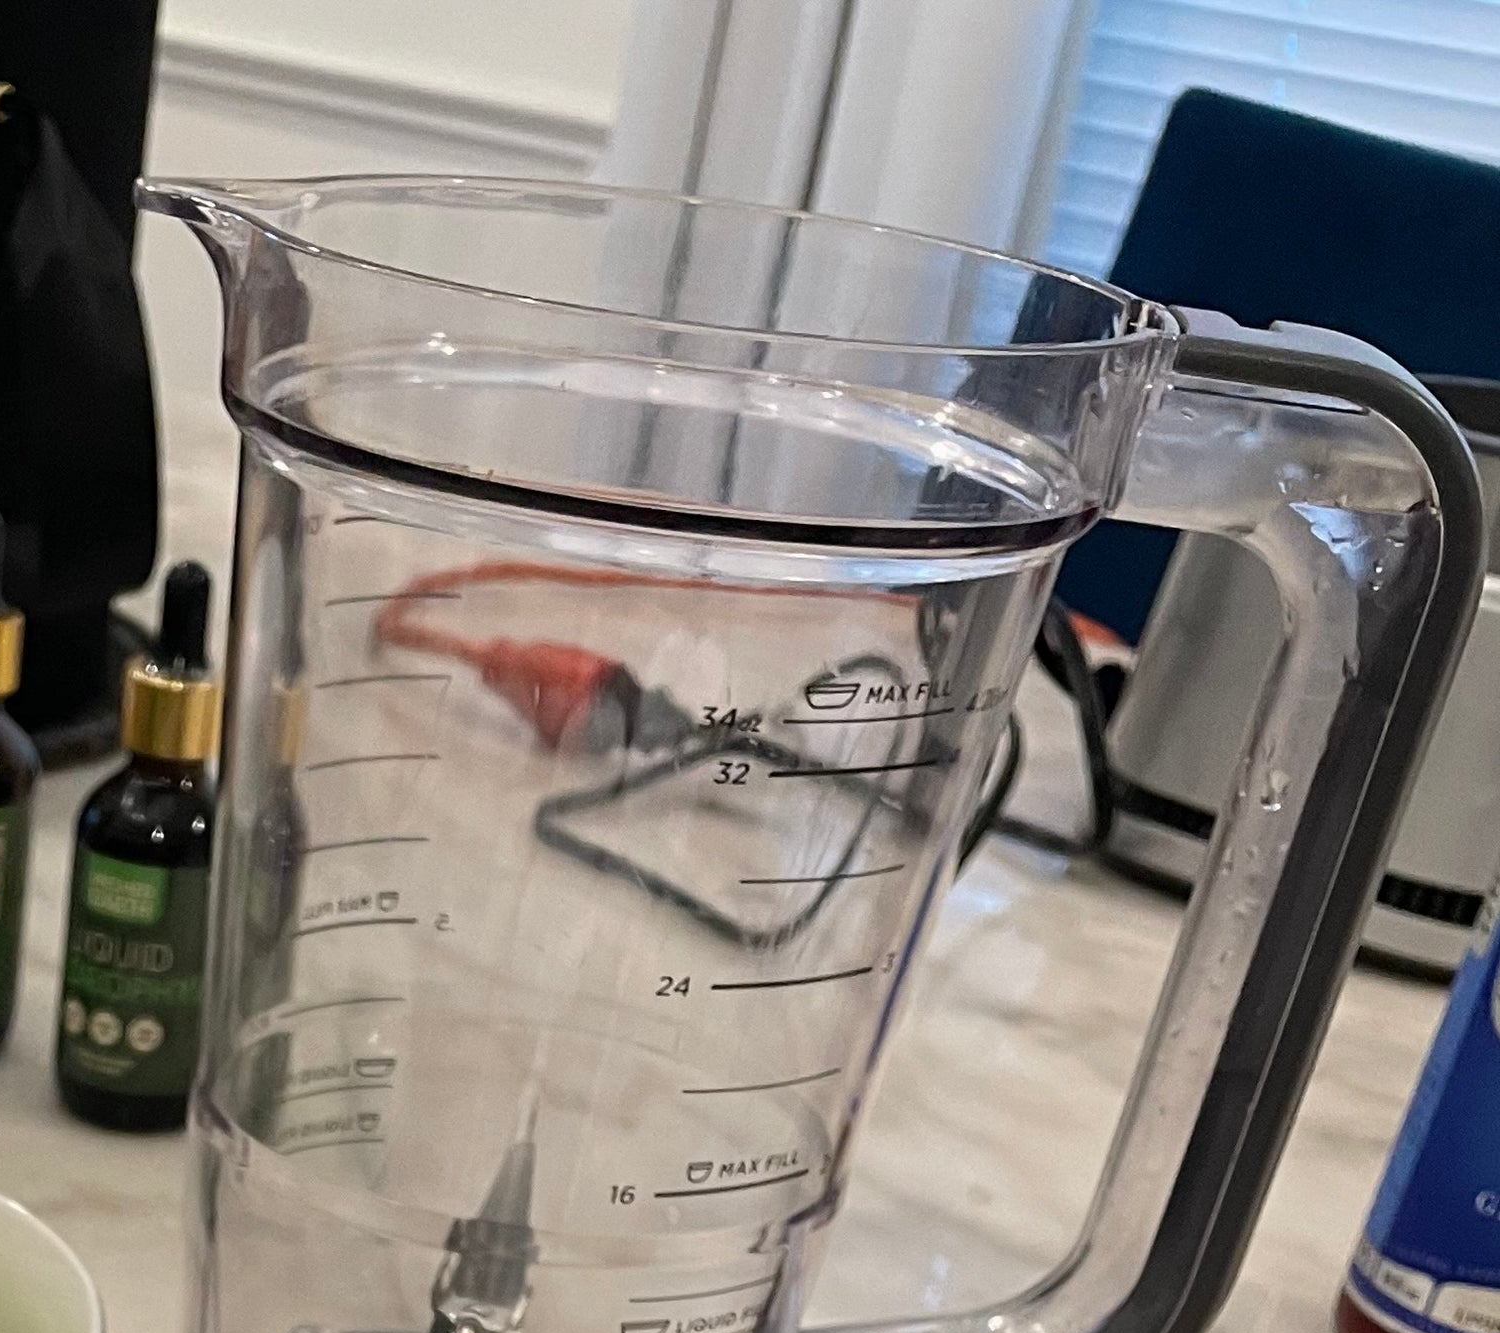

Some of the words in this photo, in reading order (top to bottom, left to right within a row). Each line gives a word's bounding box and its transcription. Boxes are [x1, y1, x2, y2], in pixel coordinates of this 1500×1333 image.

[865, 686, 907, 704] MAX
[713, 761, 750, 785] 32
[655, 975, 691, 998] 24
[610, 1185, 636, 1206] 16
[718, 1161, 759, 1180] MAX
